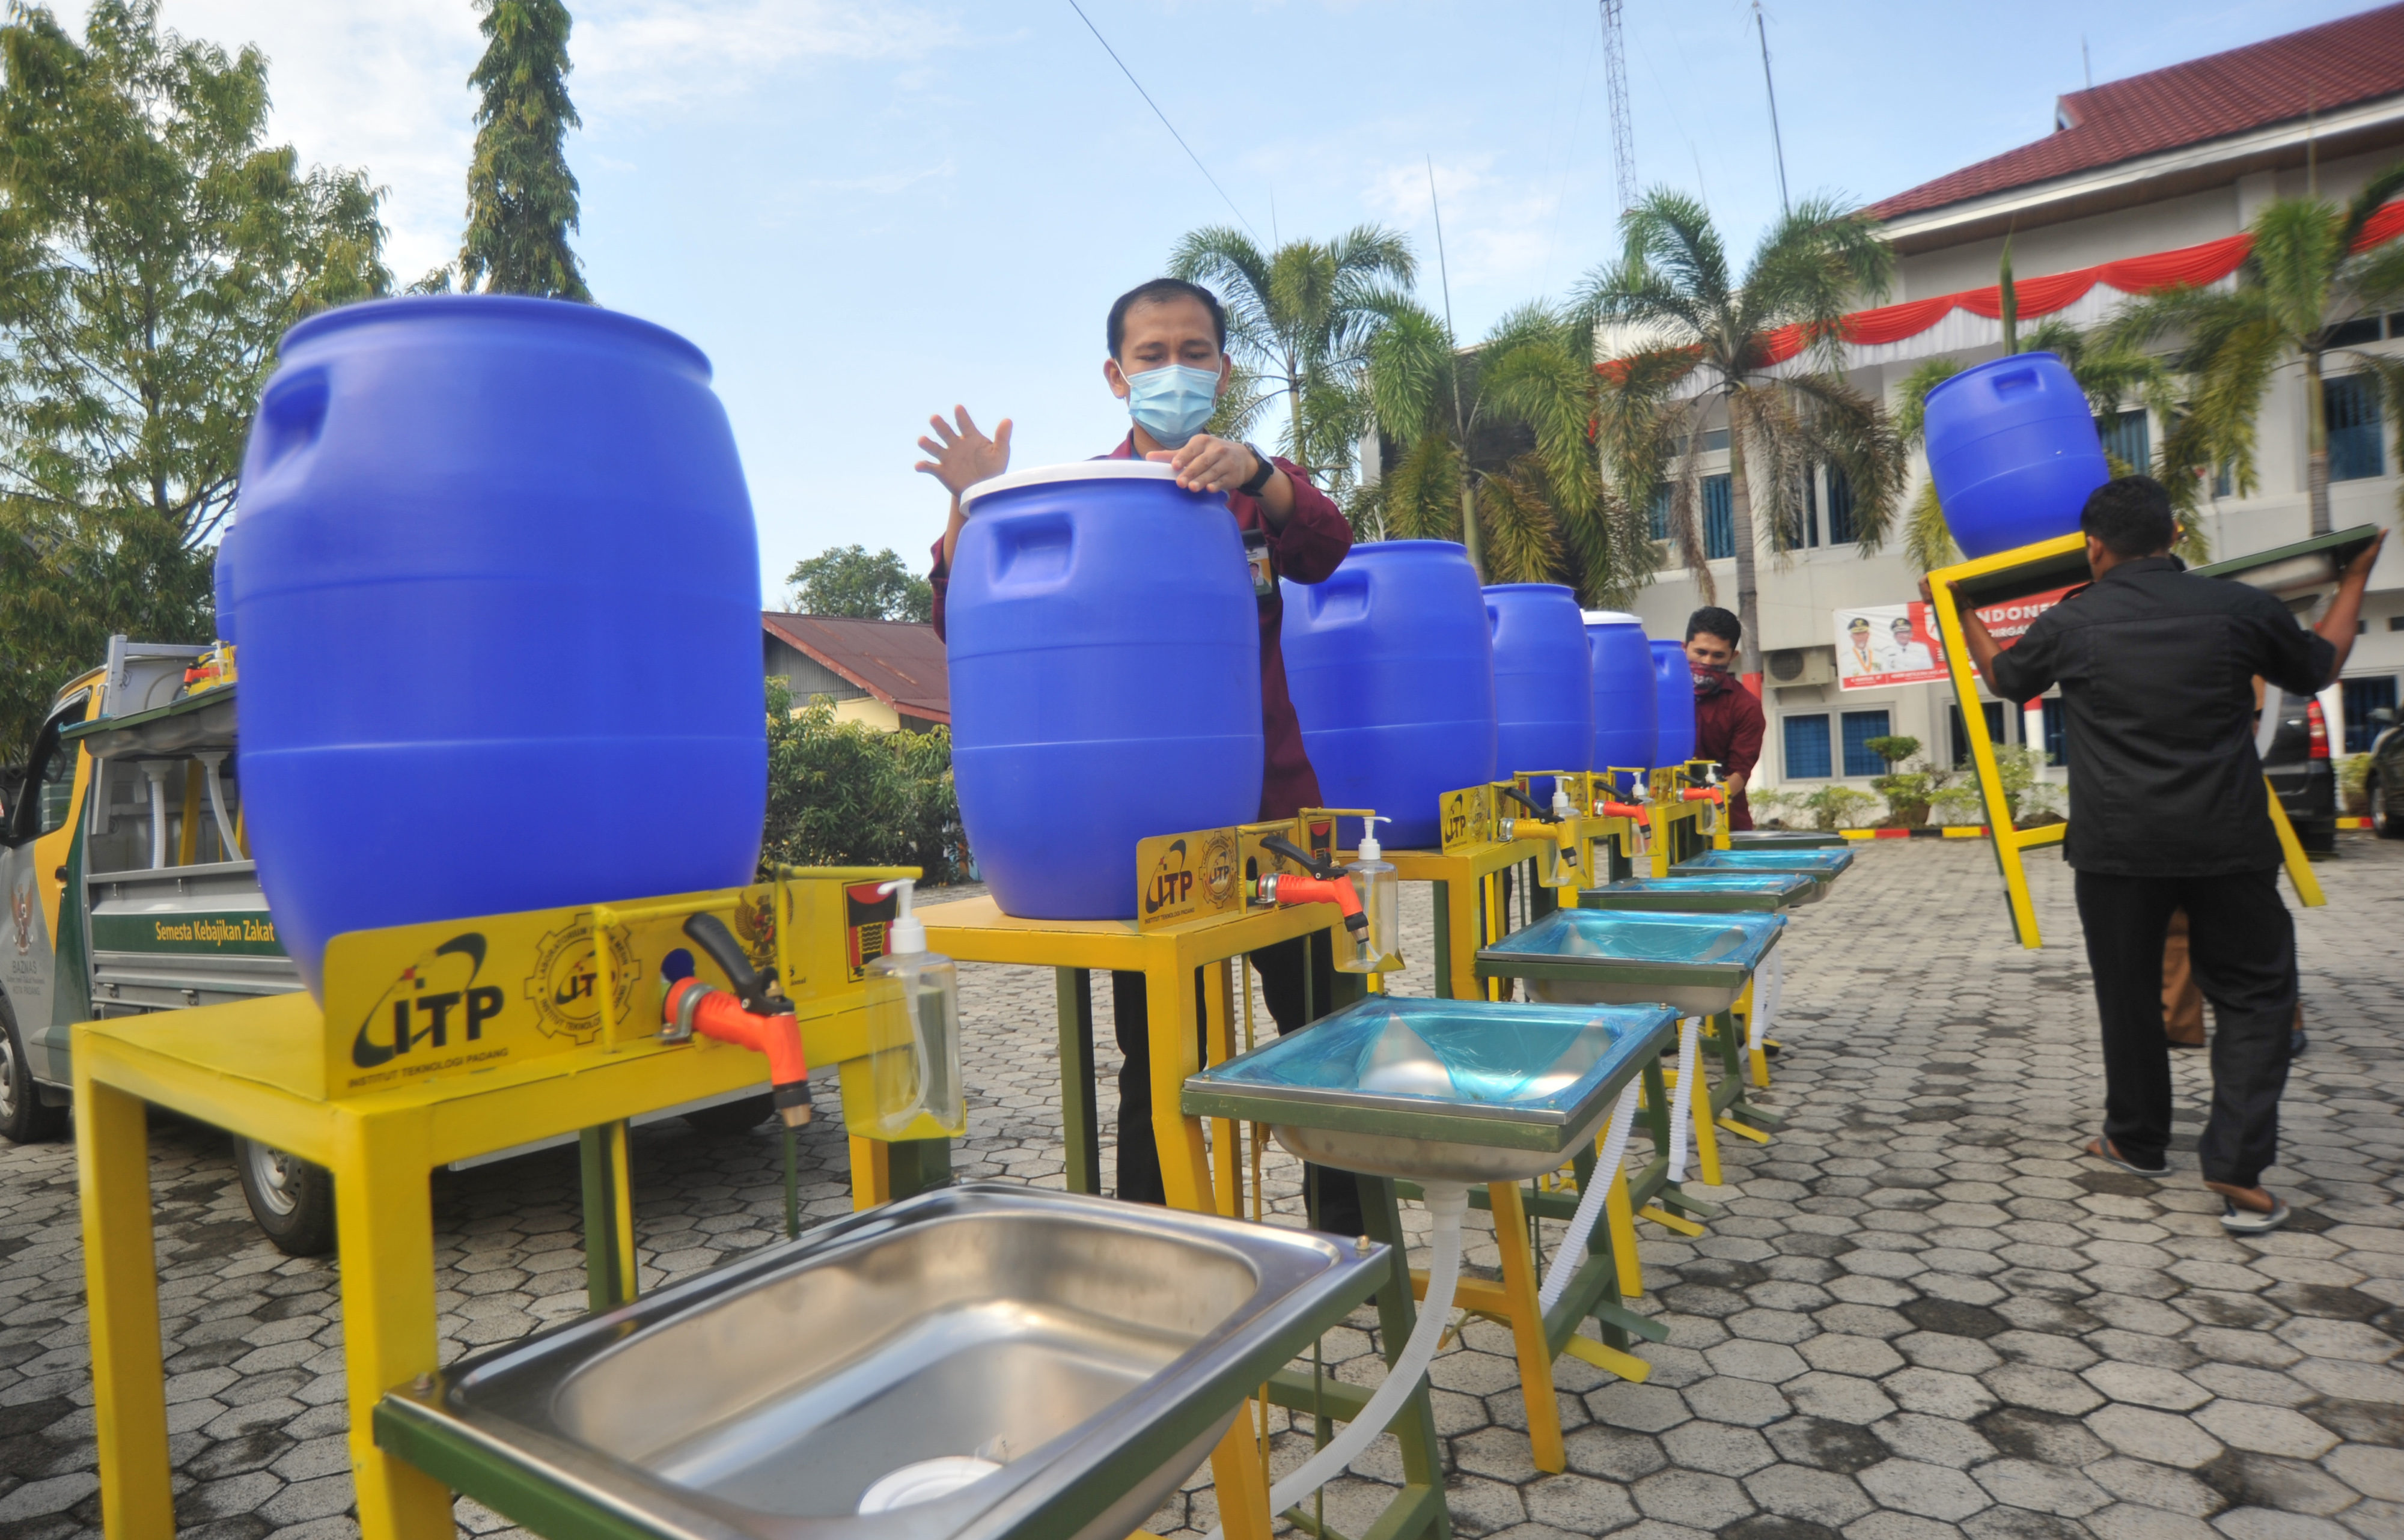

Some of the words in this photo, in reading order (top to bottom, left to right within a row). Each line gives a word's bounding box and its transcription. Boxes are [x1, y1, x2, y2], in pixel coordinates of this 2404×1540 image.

[1450, 815, 1466, 839] ITP
[1213, 865, 1230, 882] ITP
[1158, 870, 1193, 908] ITP
[1145, 916, 1161, 924] INSTITUT
[1161, 910, 1180, 920] TEKNOLOGI
[156, 921, 192, 941] Semesta
[194, 919, 242, 946] Kebajikan
[243, 919, 275, 942] Zakat
[12, 960, 37, 974] BAZNAS
[394, 985, 504, 1056] ITP
[566, 1016, 601, 1031] TEKNOLO
[348, 1070, 398, 1088] INSTITUT
[401, 1057, 463, 1077] TEKNOLOGI
[466, 1047, 509, 1064] PADANG
